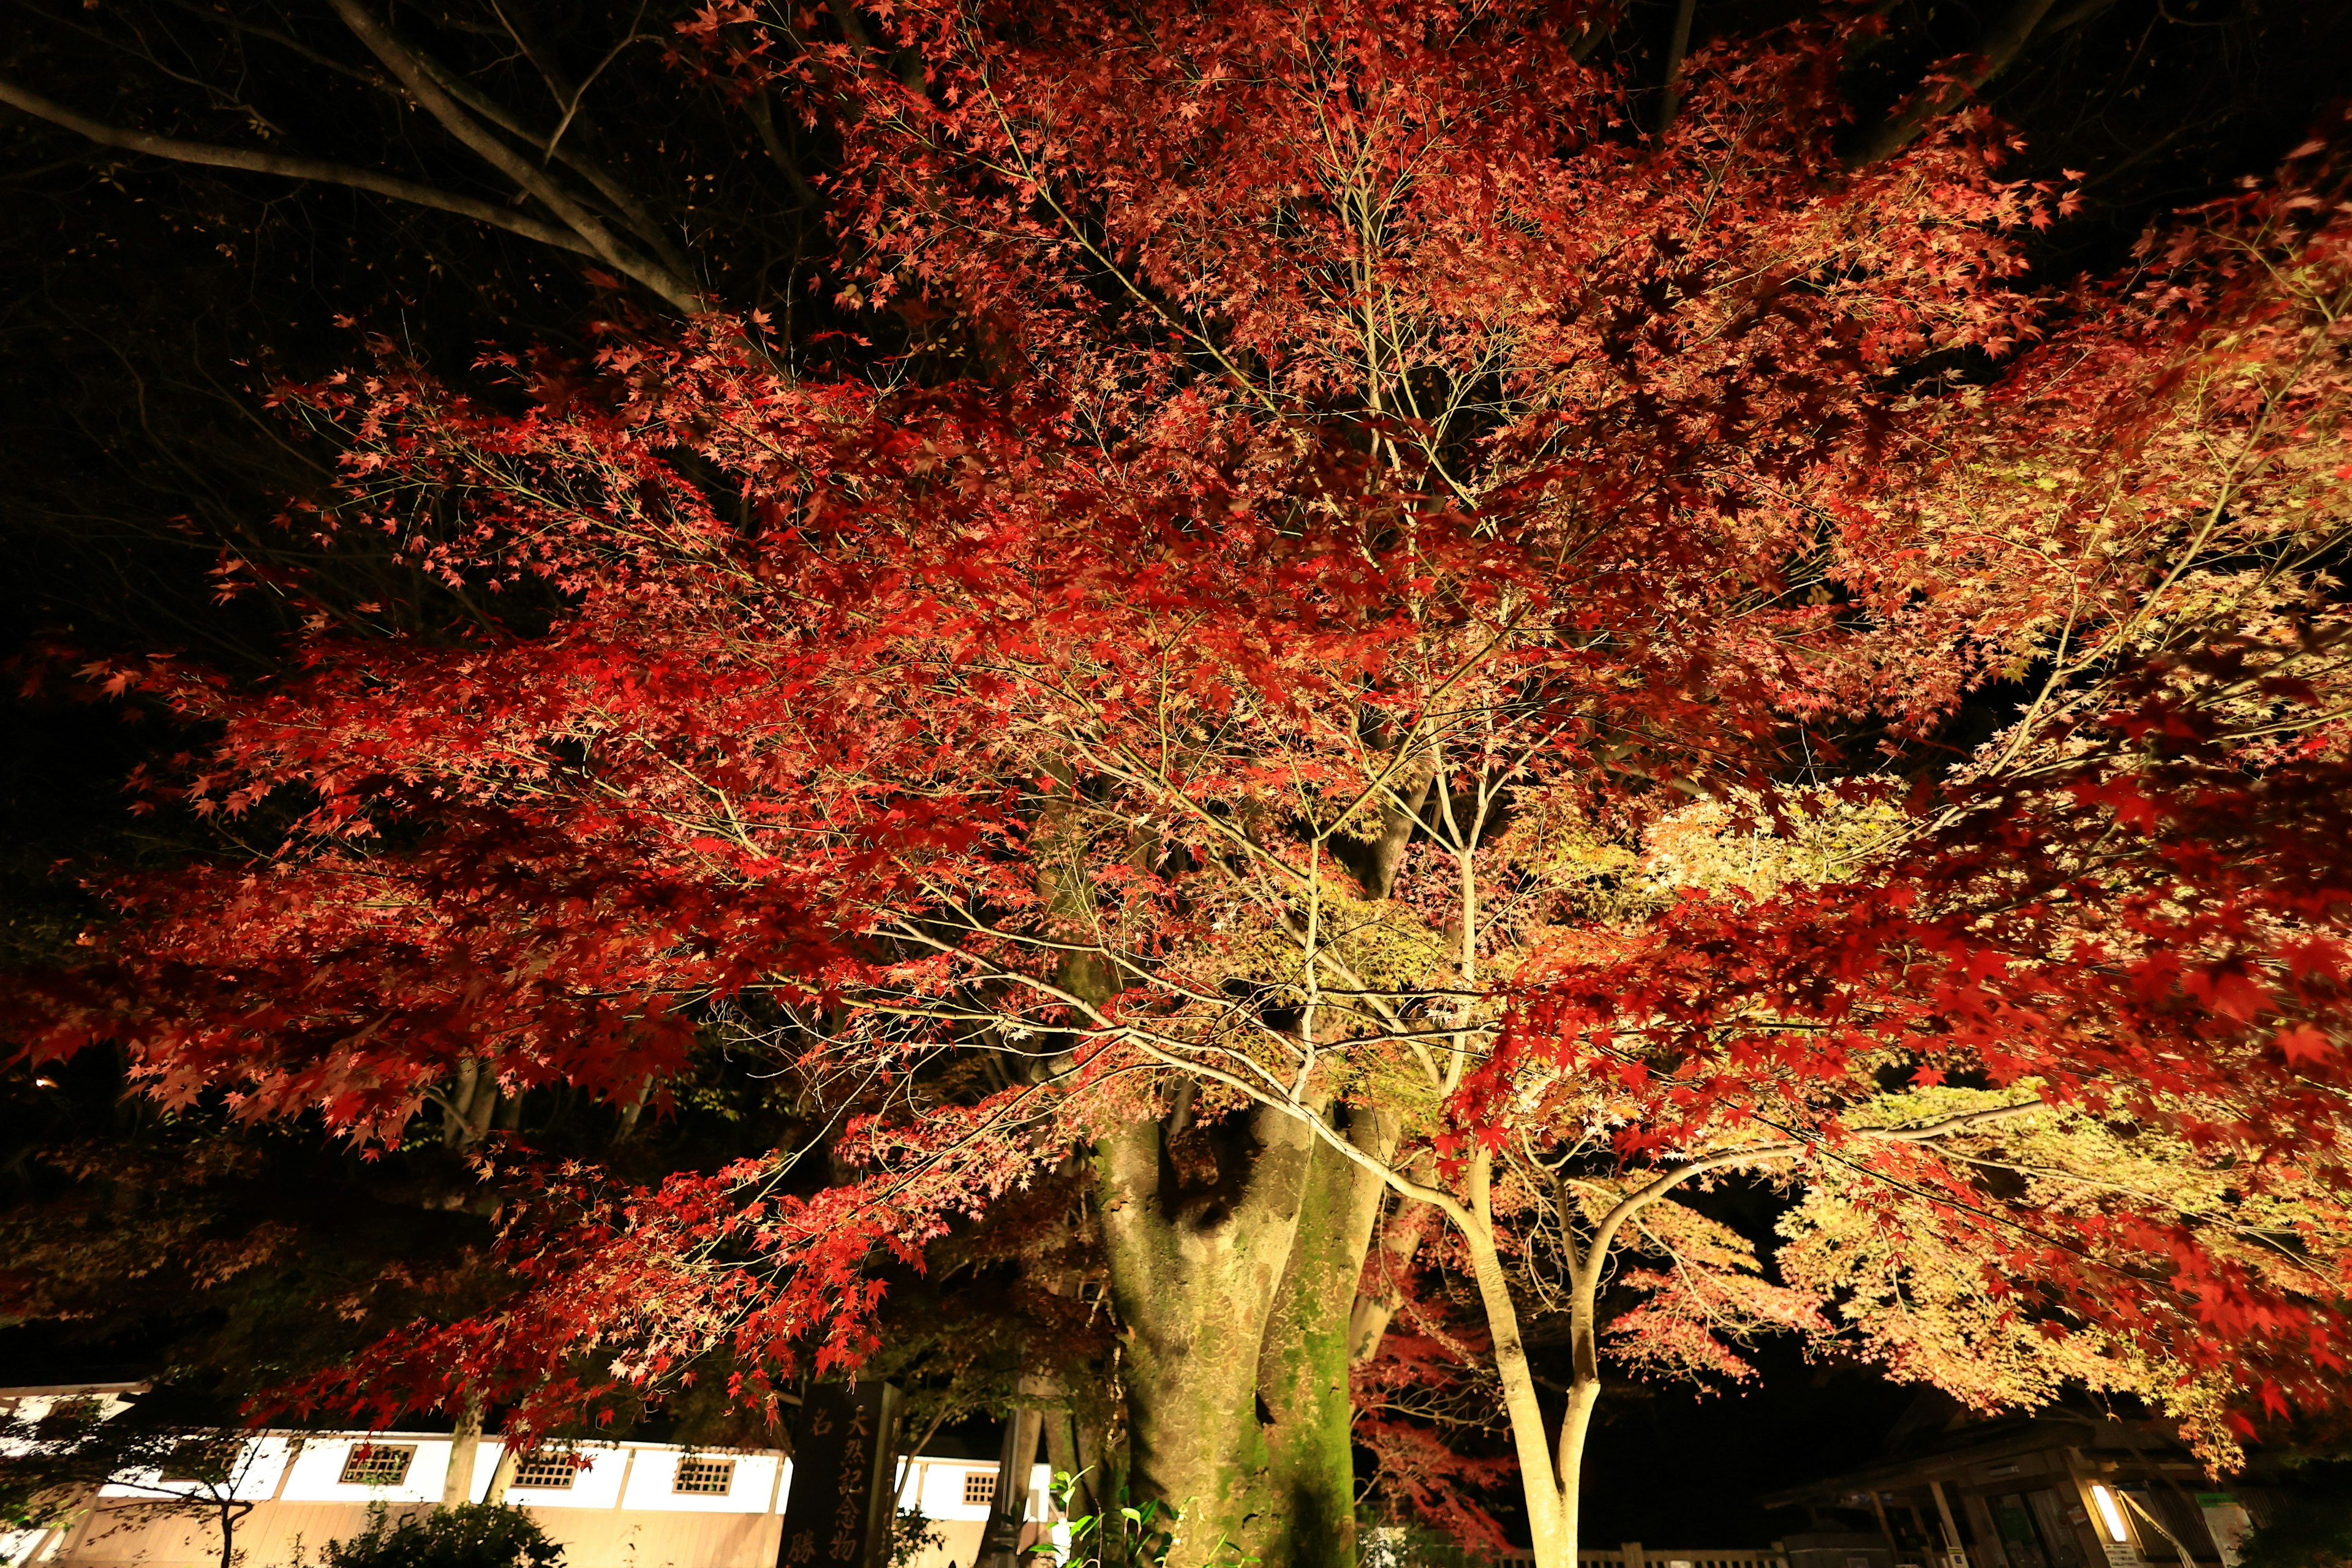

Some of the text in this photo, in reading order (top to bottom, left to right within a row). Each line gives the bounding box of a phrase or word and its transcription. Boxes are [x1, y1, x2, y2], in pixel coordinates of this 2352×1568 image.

[829, 1404, 870, 1562] 天然記念物
